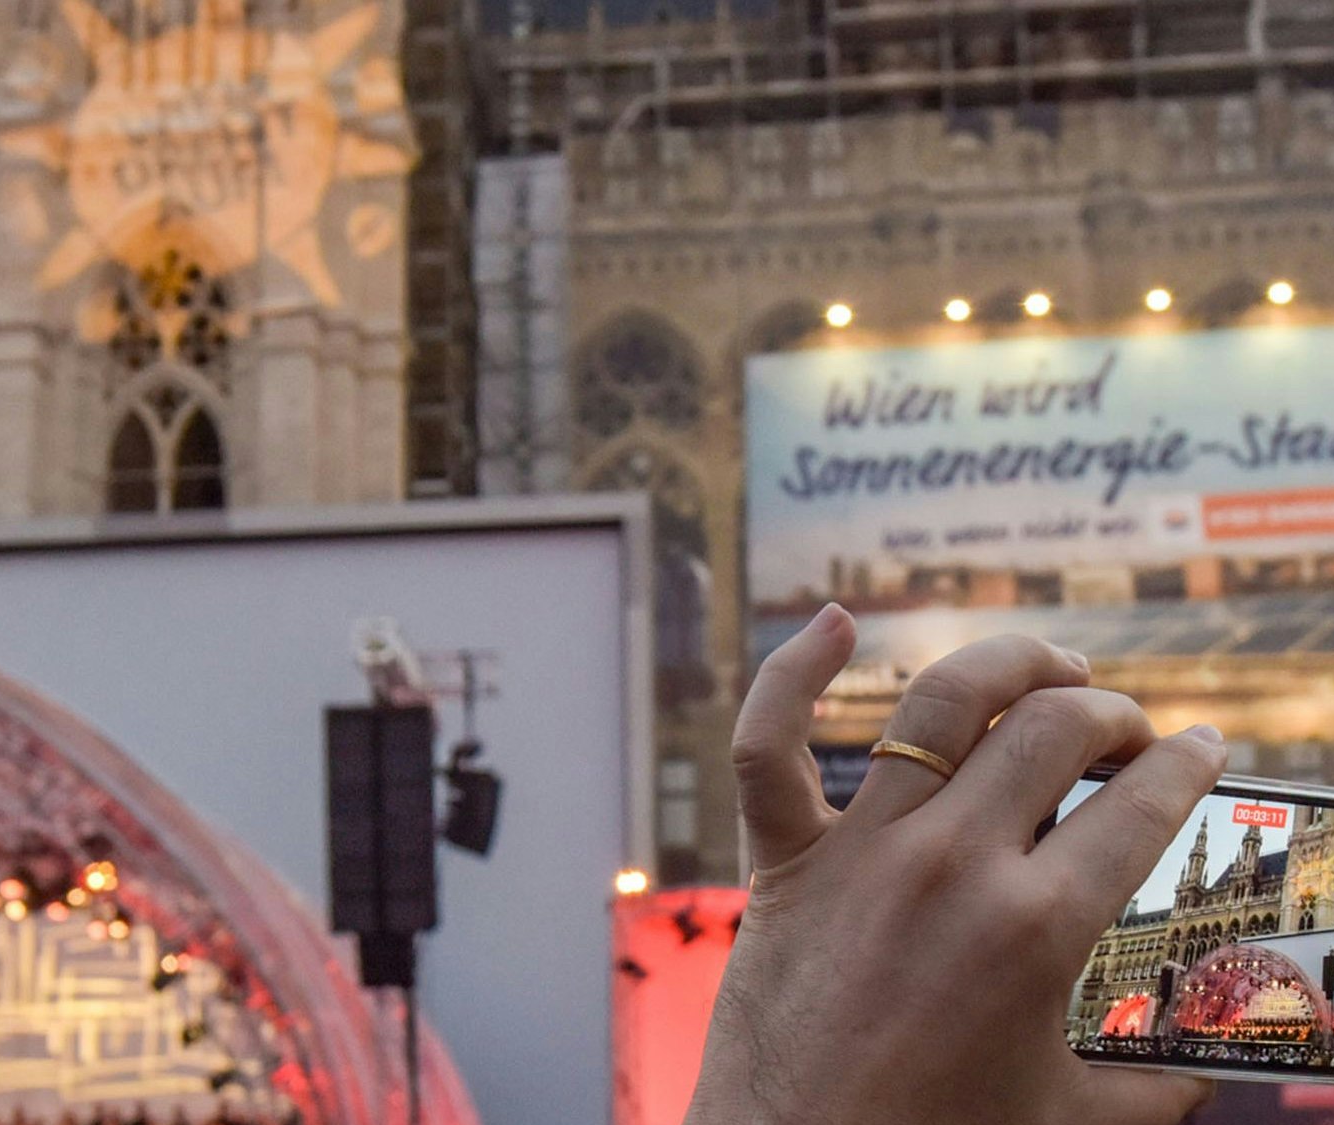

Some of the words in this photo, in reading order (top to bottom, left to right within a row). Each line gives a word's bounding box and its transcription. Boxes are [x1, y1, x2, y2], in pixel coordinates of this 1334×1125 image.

[823, 366, 957, 431] Wien
[978, 353, 1117, 421] wird
[1235, 808, 1284, 825] 00:03:11
